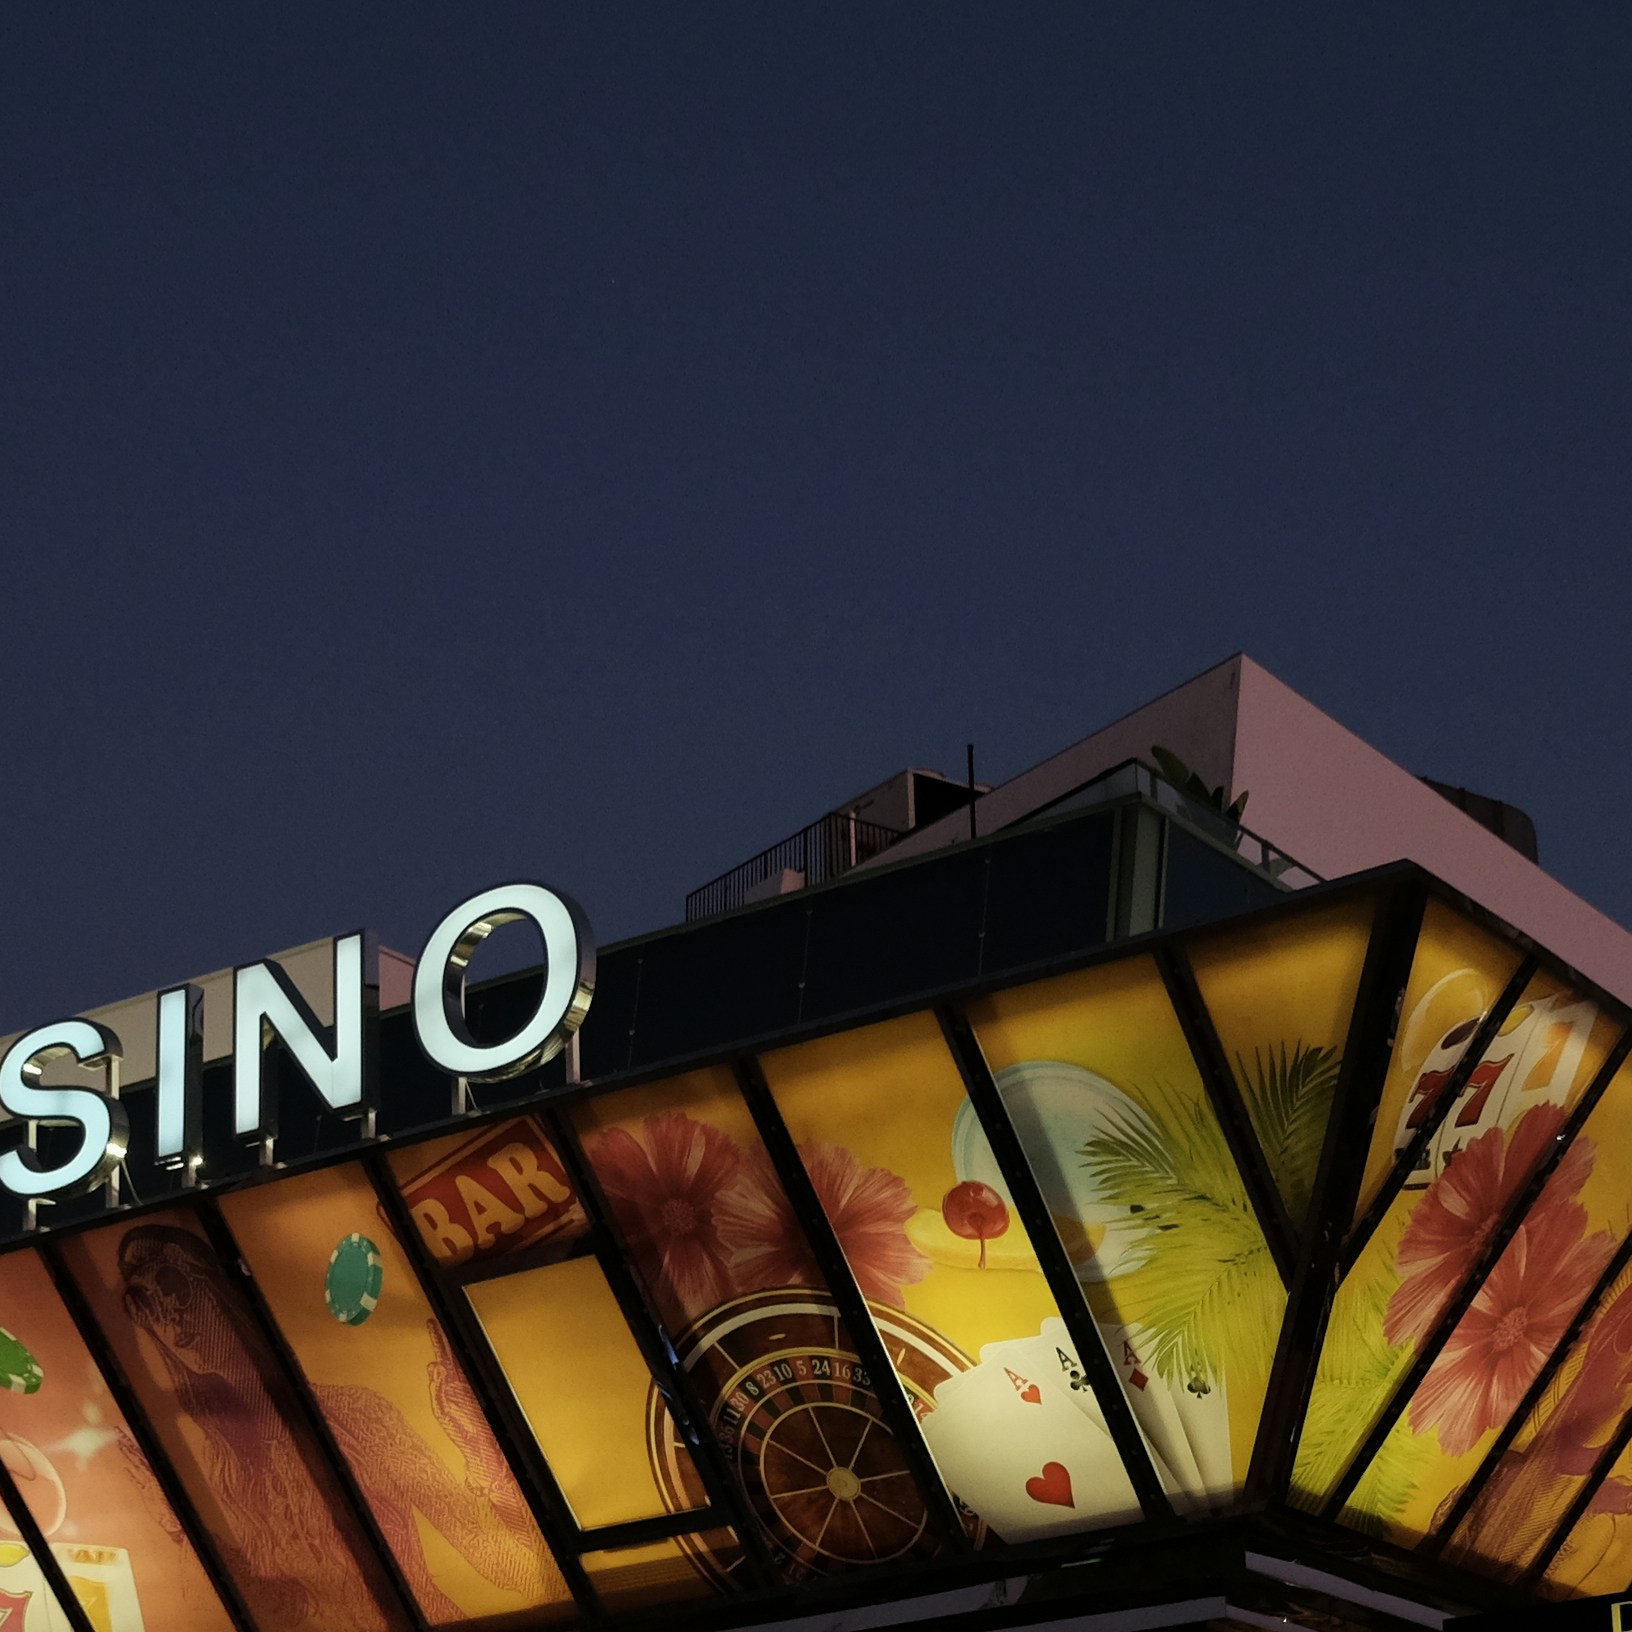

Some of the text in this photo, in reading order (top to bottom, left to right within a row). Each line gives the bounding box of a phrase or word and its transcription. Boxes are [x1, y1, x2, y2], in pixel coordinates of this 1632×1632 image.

[410, 1142, 571, 1268] BAR
[1055, 1346, 1078, 1372] A
[1123, 1341, 1142, 1366] A
[744, 1380, 760, 1396] 8
[756, 1370, 777, 1389] 23
[773, 1363, 793, 1381] 10
[795, 1360, 807, 1375] 5
[812, 1359, 831, 1375] 24
[834, 1362, 851, 1379] 16
[1004, 1366, 1029, 1391] A
